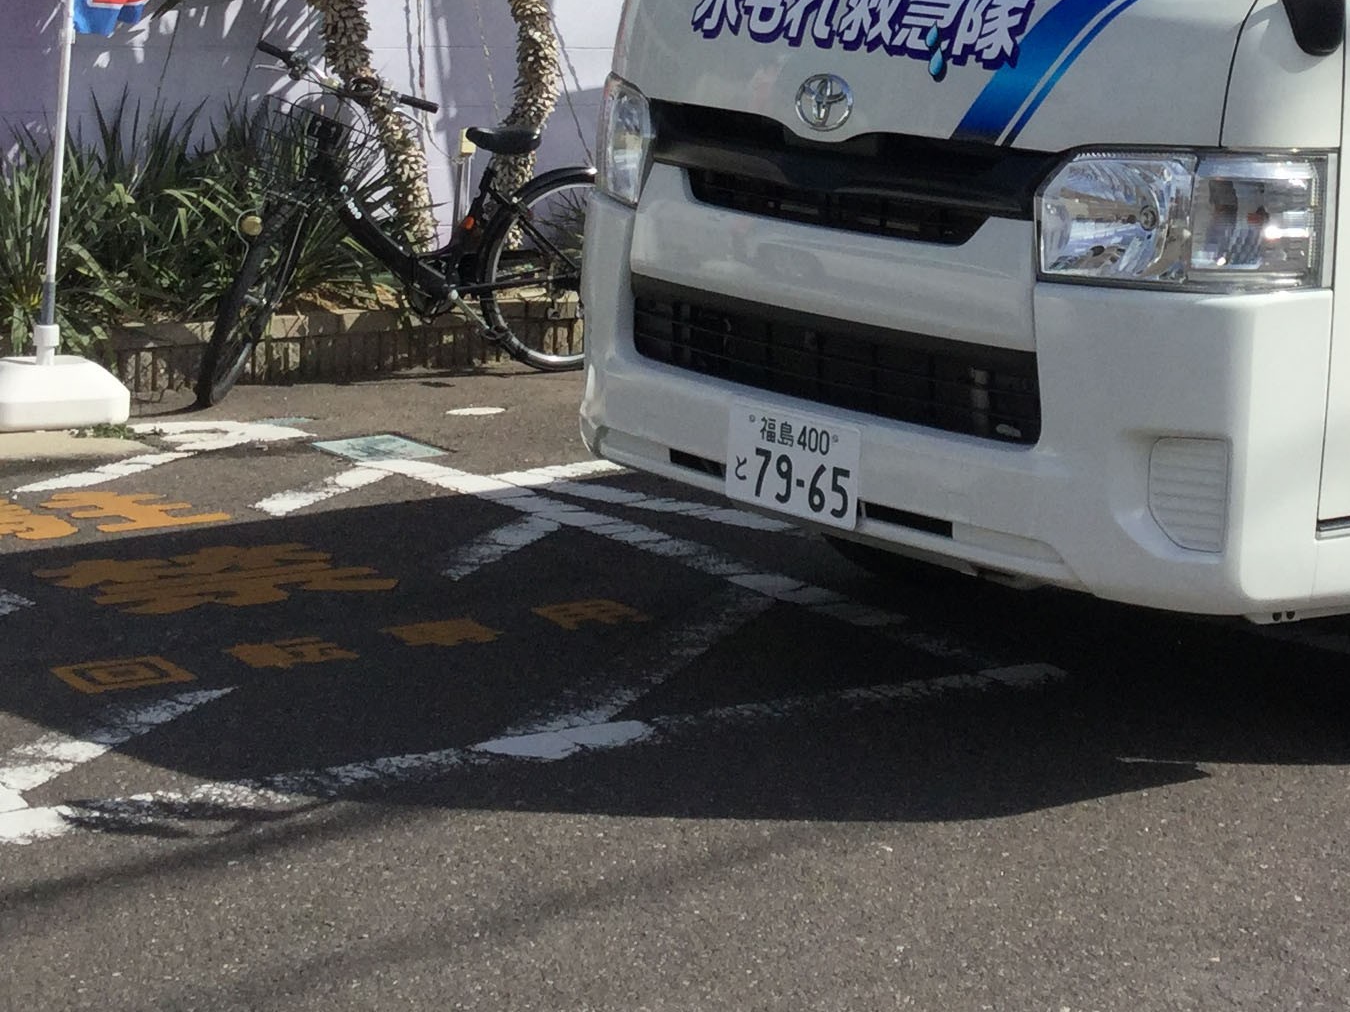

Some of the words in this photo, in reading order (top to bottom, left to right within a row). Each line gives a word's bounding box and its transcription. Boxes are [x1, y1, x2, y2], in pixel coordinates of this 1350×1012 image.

[760, 416, 794, 447] 福島
[797, 426, 830, 455] 400
[734, 455, 748, 481] と
[754, 447, 851, 519] 79-65
